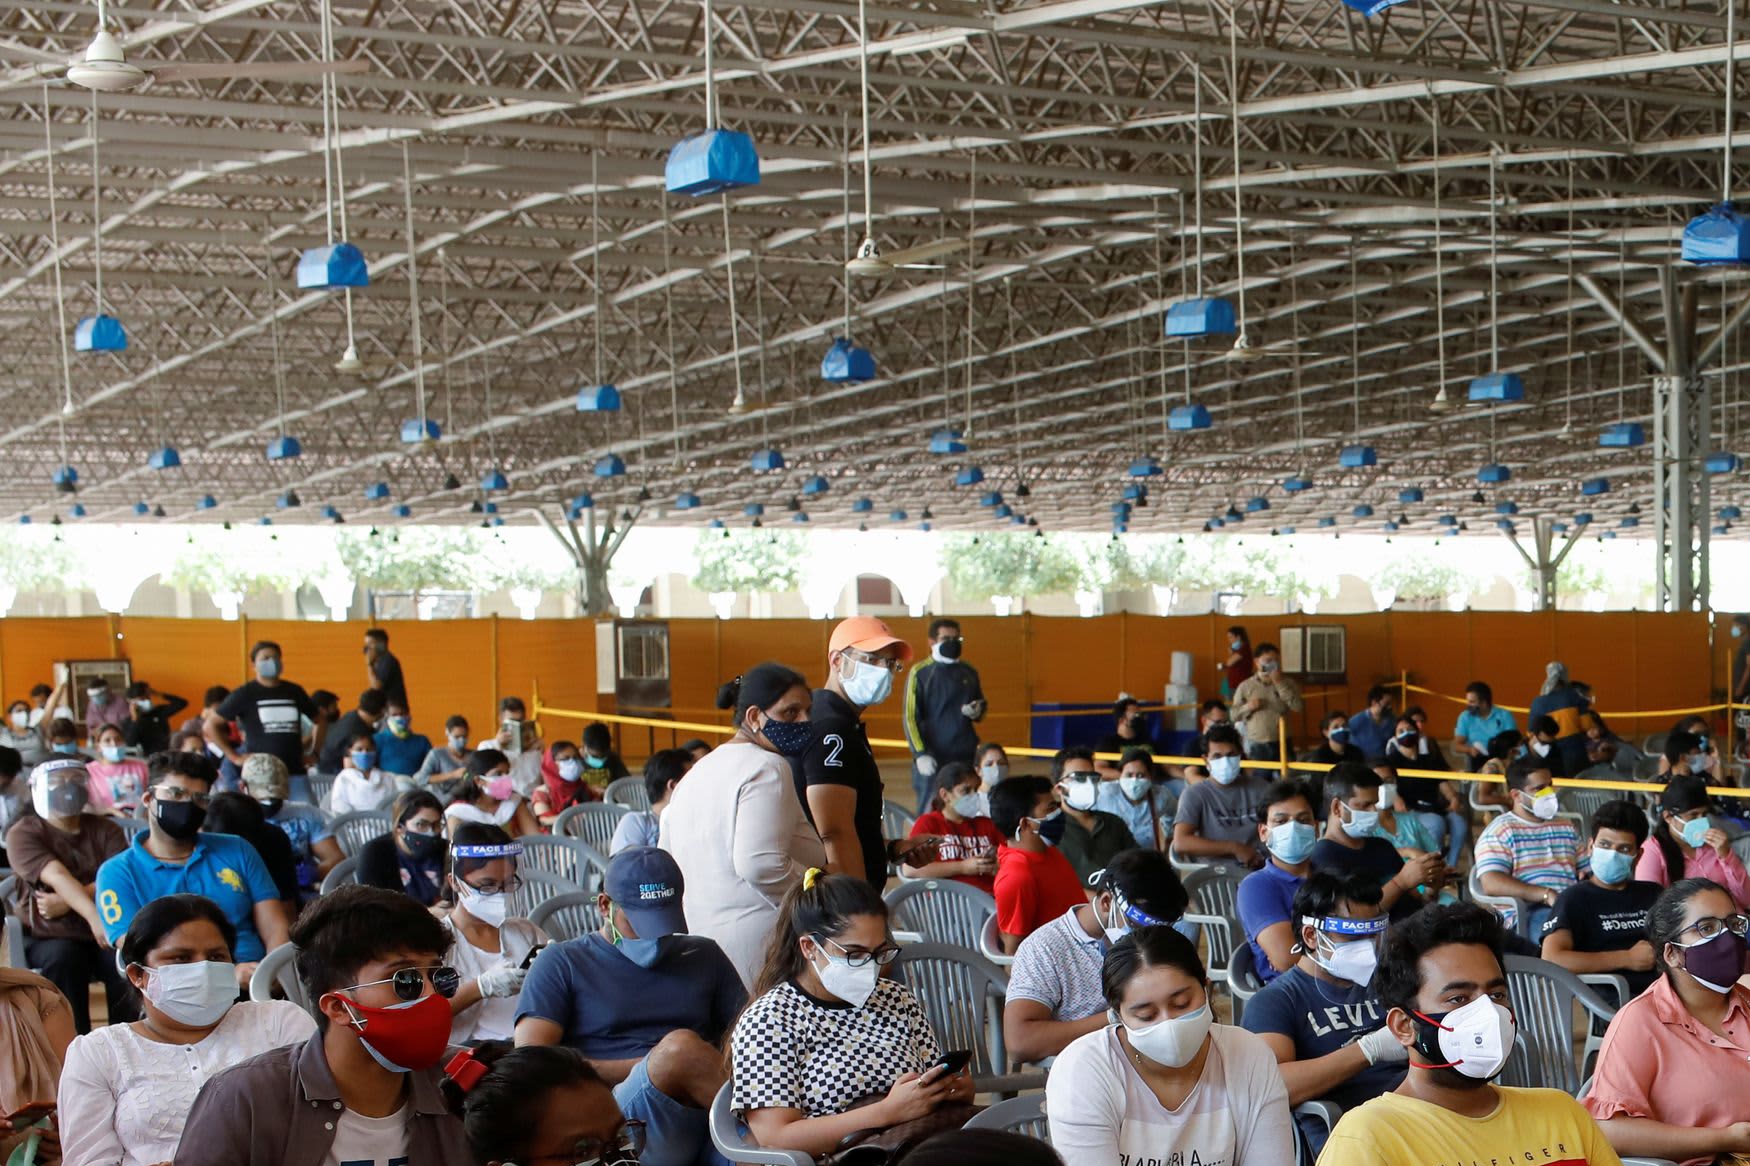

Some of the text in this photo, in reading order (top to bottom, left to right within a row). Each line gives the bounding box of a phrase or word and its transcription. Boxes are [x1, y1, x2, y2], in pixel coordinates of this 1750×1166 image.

[823, 734, 844, 767] 2
[472, 845, 500, 853] FACE
[639, 883, 666, 892] SERVE
[100, 889, 122, 925] 8
[1342, 921, 1371, 929] FACE
